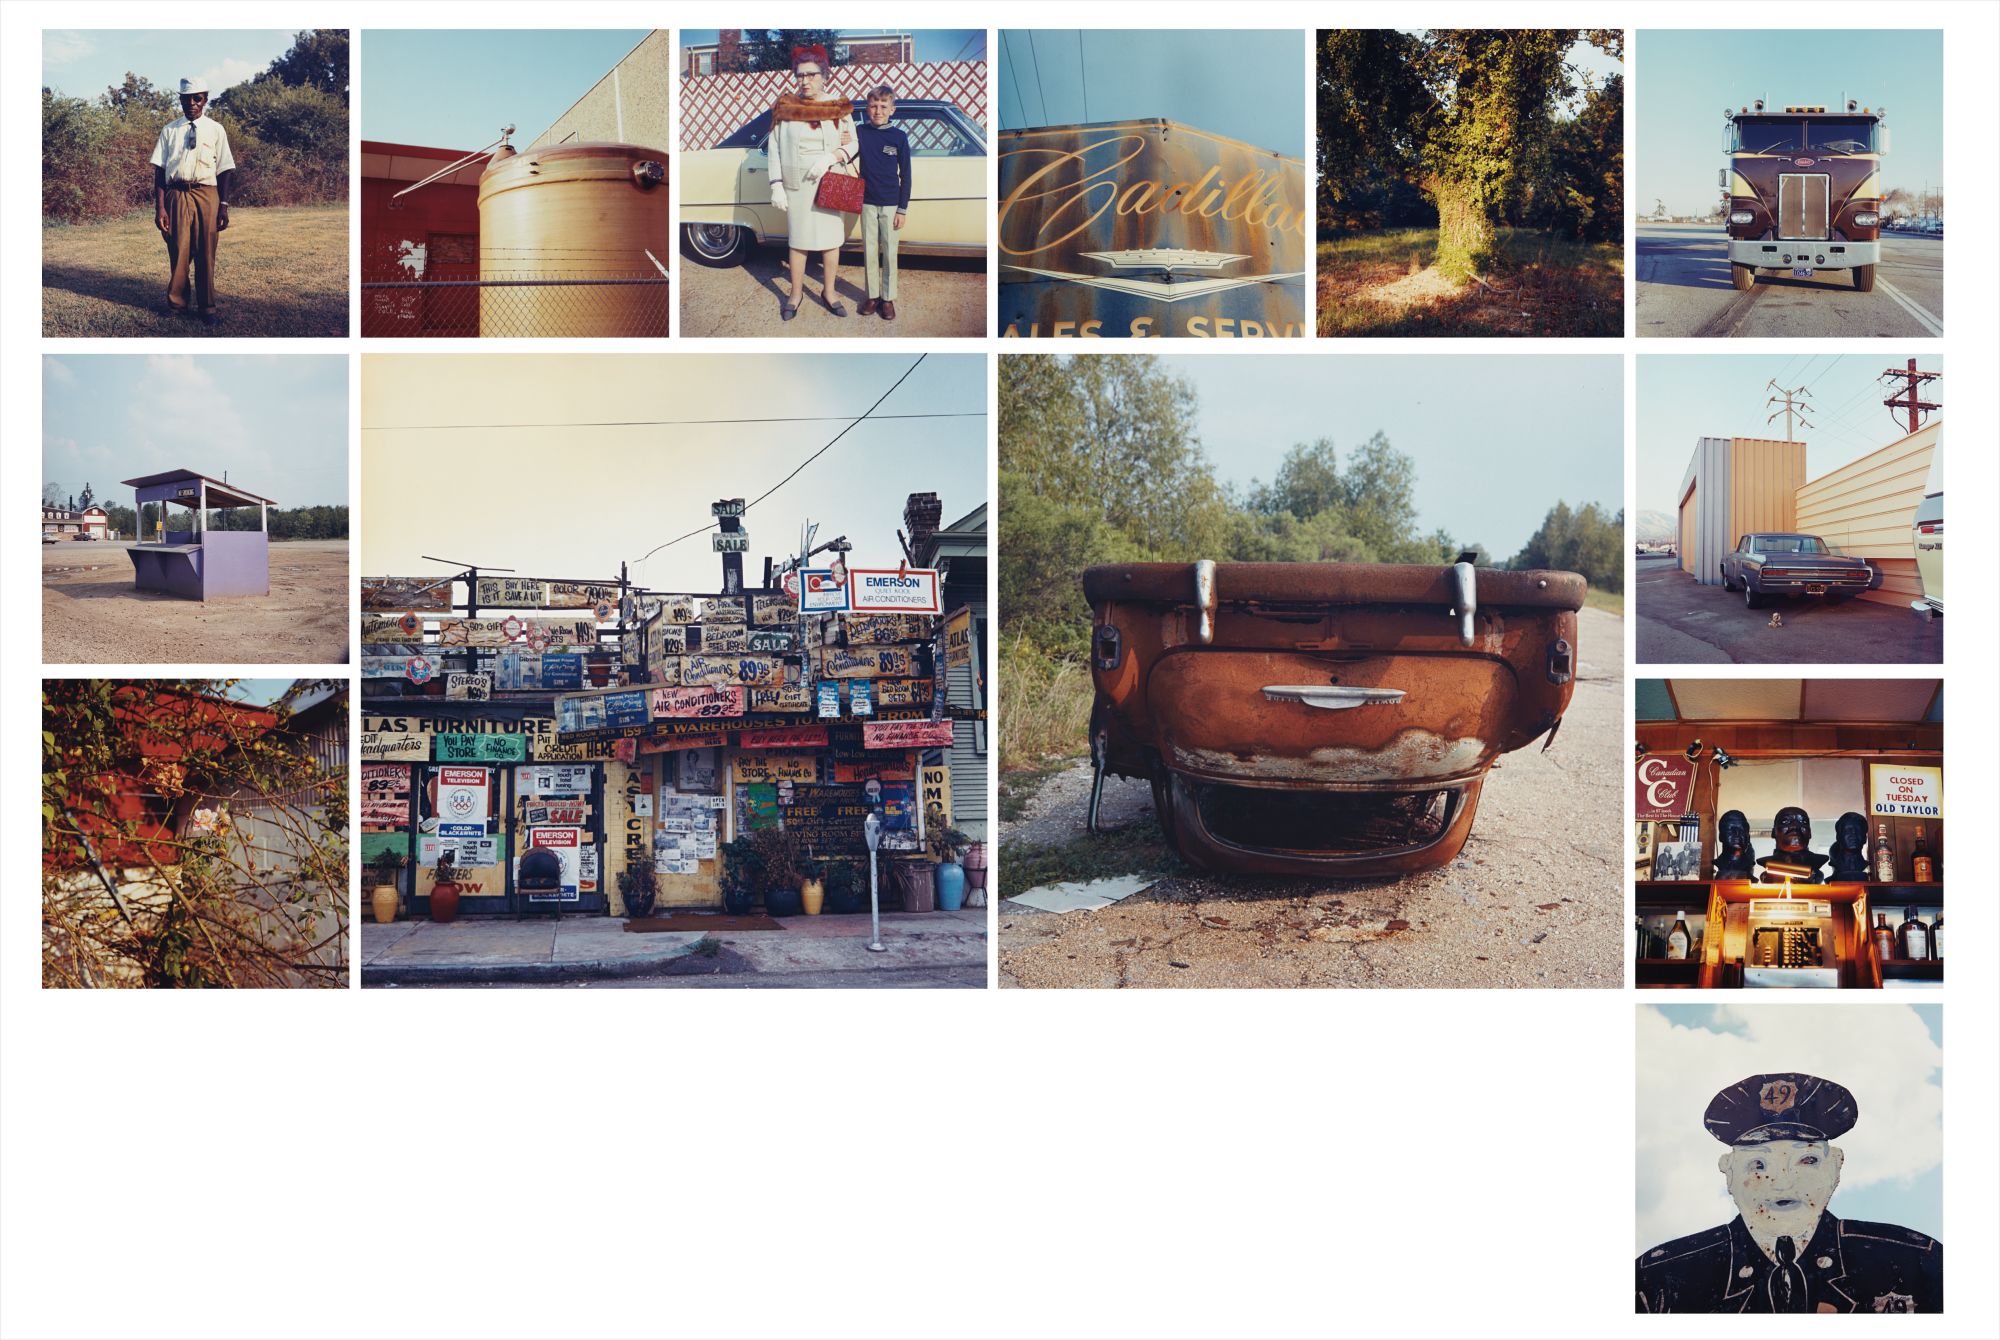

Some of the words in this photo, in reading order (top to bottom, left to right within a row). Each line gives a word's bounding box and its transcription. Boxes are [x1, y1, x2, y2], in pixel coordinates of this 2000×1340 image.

[714, 503, 742, 515] SALE
[717, 539, 747, 552] SALE
[482, 582, 498, 594] THIS
[505, 580, 518, 590] BUY
[521, 581, 540, 591] HERE
[553, 583, 579, 594] COLOR
[866, 577, 920, 588] EMERSON
[482, 594, 491, 604] IS
[493, 591, 501, 601] IT
[505, 592, 522, 601] SAVE
[523, 592, 529, 601] A
[950, 628, 970, 648] ATLAS
[753, 639, 788, 650] SALE
[834, 651, 849, 663] AIR
[690, 657, 705, 671] AIR
[663, 690, 678, 700] NEW
[755, 690, 780, 706] FREE!
[654, 700, 671, 713] AIR
[675, 690, 737, 711] CONDITIONERS
[363, 718, 409, 733] LAS
[420, 719, 552, 734] FURNITURE
[656, 725, 668, 735] 5
[674, 717, 786, 734] WAREHOUSES
[795, 716, 813, 726] TO
[878, 710, 925, 720] FROM
[461, 735, 476, 747] PAY
[494, 738, 506, 747] NO
[873, 733, 885, 741] NO
[448, 747, 476, 758] STORE
[486, 744, 517, 756] FINANCE
[545, 744, 579, 755] CREDIT
[586, 740, 616, 758] HERE
[537, 751, 583, 761] APPLICATION
[444, 770, 483, 778] EMERSON
[742, 768, 769, 778] STORE
[778, 768, 802, 778] FINANCE
[924, 771, 944, 784] NO
[1649, 767, 1687, 776] Canadian
[1890, 777, 1924, 785] CLOSED
[1886, 793, 1928, 803] TUESDAY
[787, 807, 818, 816] FREE
[837, 806, 869, 816] FREE
[1876, 803, 1896, 812] OLD
[1900, 805, 1939, 815] TAYLOR
[550, 809, 584, 824] SALE
[536, 831, 574, 839] EMERSON
[1764, 1085, 1791, 1105] 49
